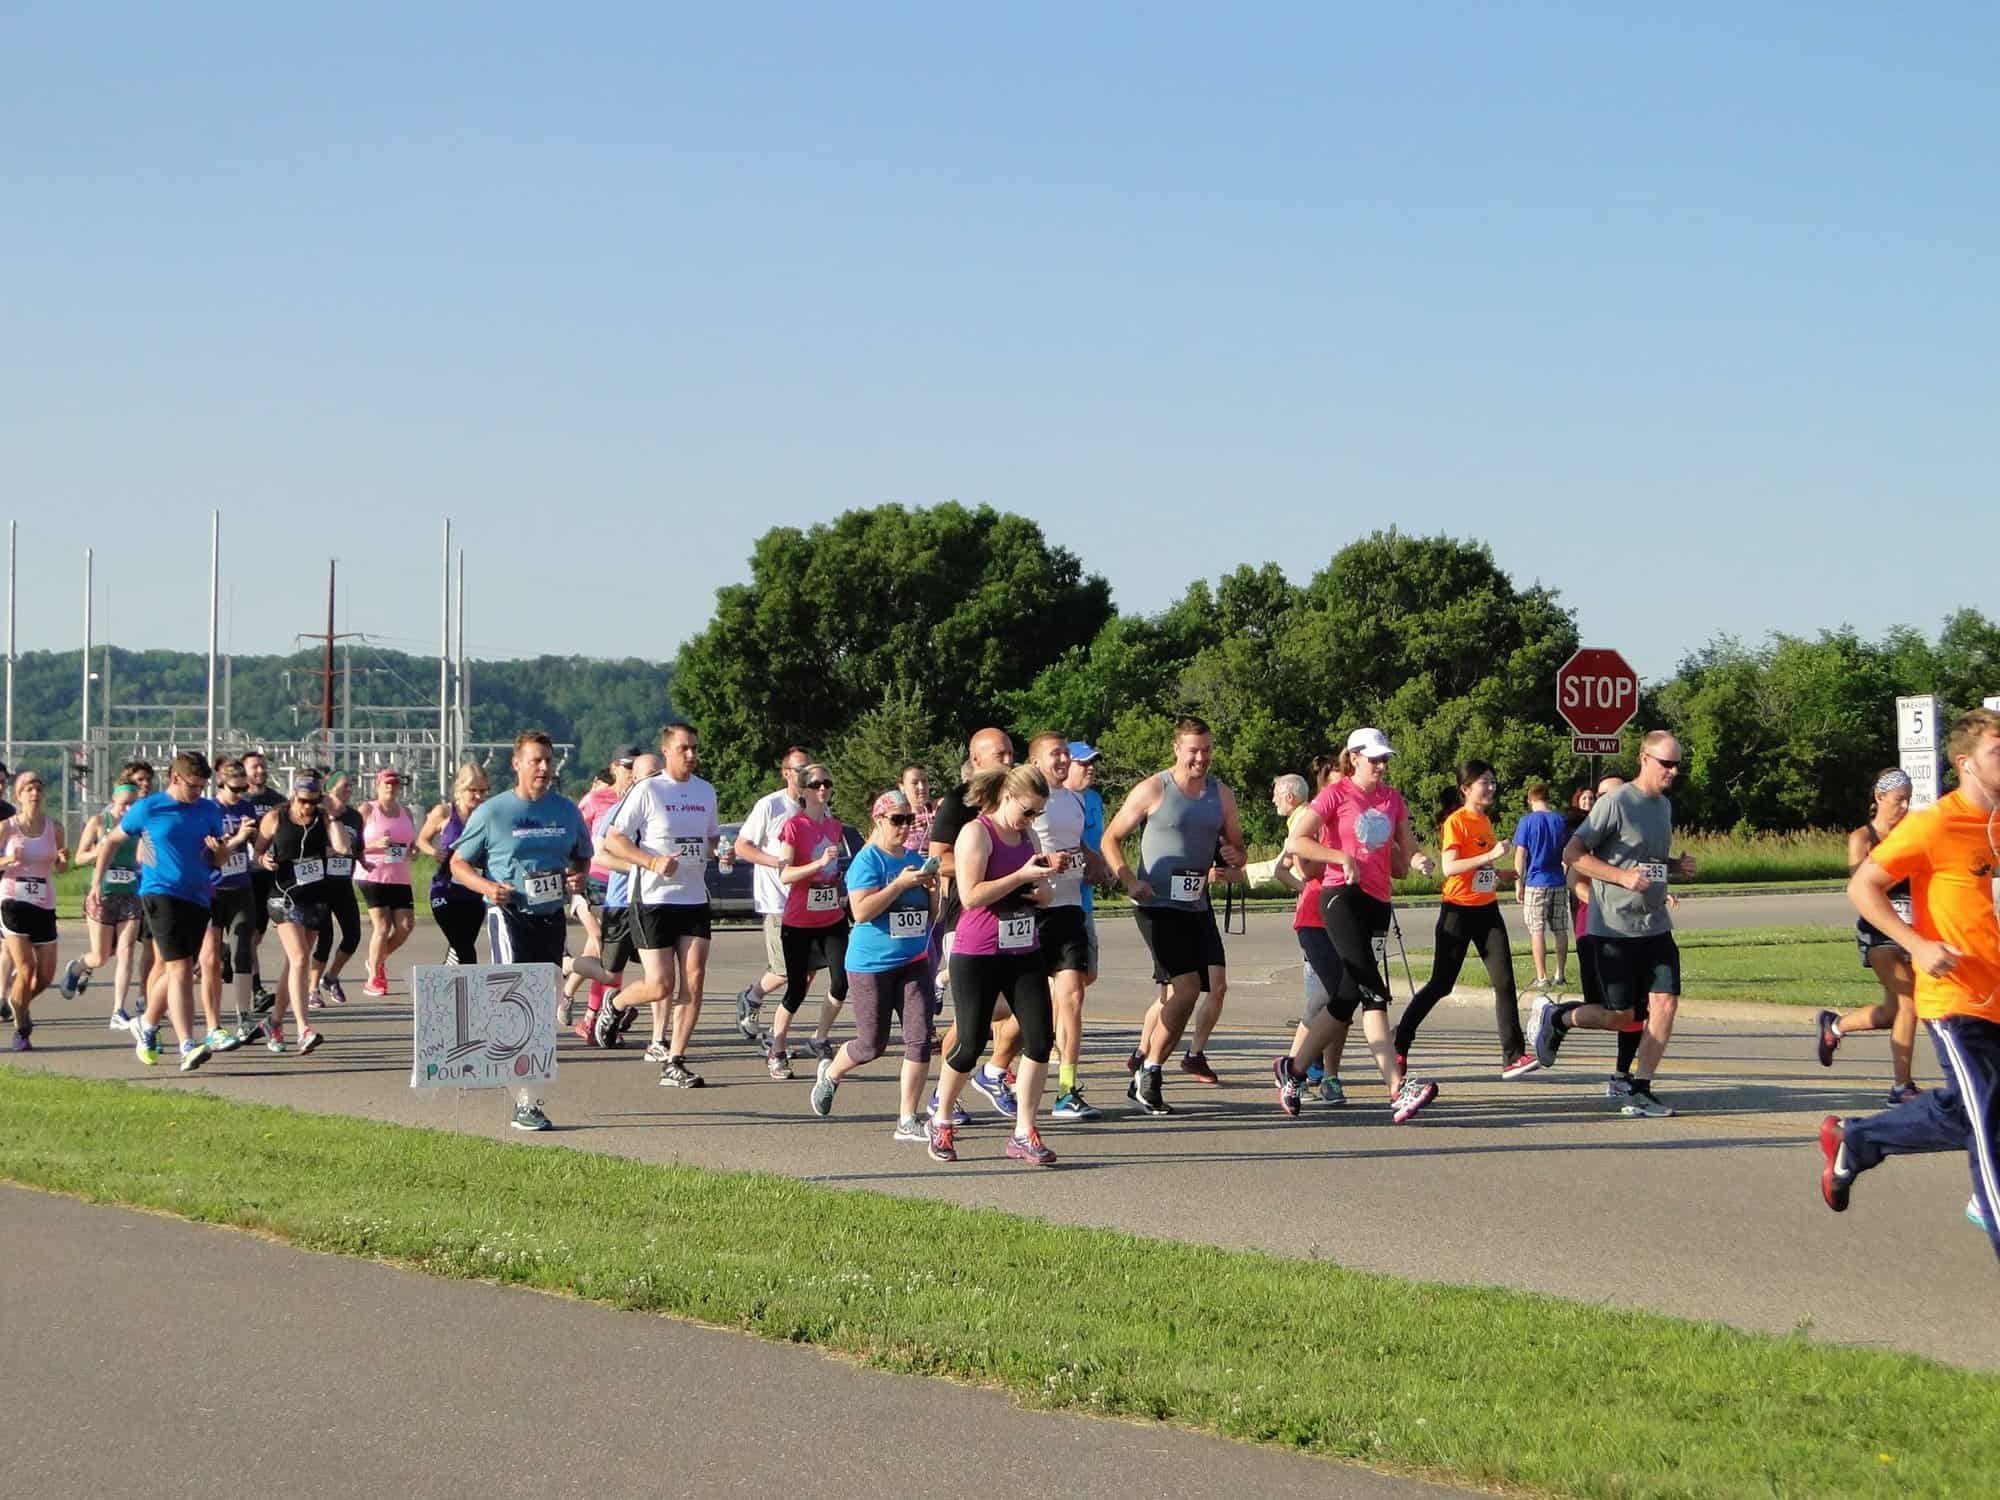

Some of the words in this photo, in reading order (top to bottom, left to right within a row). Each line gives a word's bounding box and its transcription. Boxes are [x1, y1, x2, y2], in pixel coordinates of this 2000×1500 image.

[1564, 675, 1632, 708] STOP
[1913, 711, 1923, 734] 5
[1577, 740, 1593, 751] ALL
[1599, 740, 1617, 751] WAY
[1906, 765, 1931, 779] CLOSED
[392, 848, 402, 857] 58
[681, 845, 700, 856] 244
[301, 863, 319, 875] 285
[25, 884, 39, 894] 42
[534, 877, 557, 893] 214
[1184, 878, 1200, 891] 82
[814, 890, 833, 901] 243
[897, 913, 922, 926] 303
[1008, 920, 1031, 936] 127
[444, 972, 535, 1064] 13
[427, 1063, 476, 1080] POUR
[486, 1063, 499, 1078] IT
[514, 1047, 554, 1079] ON!
